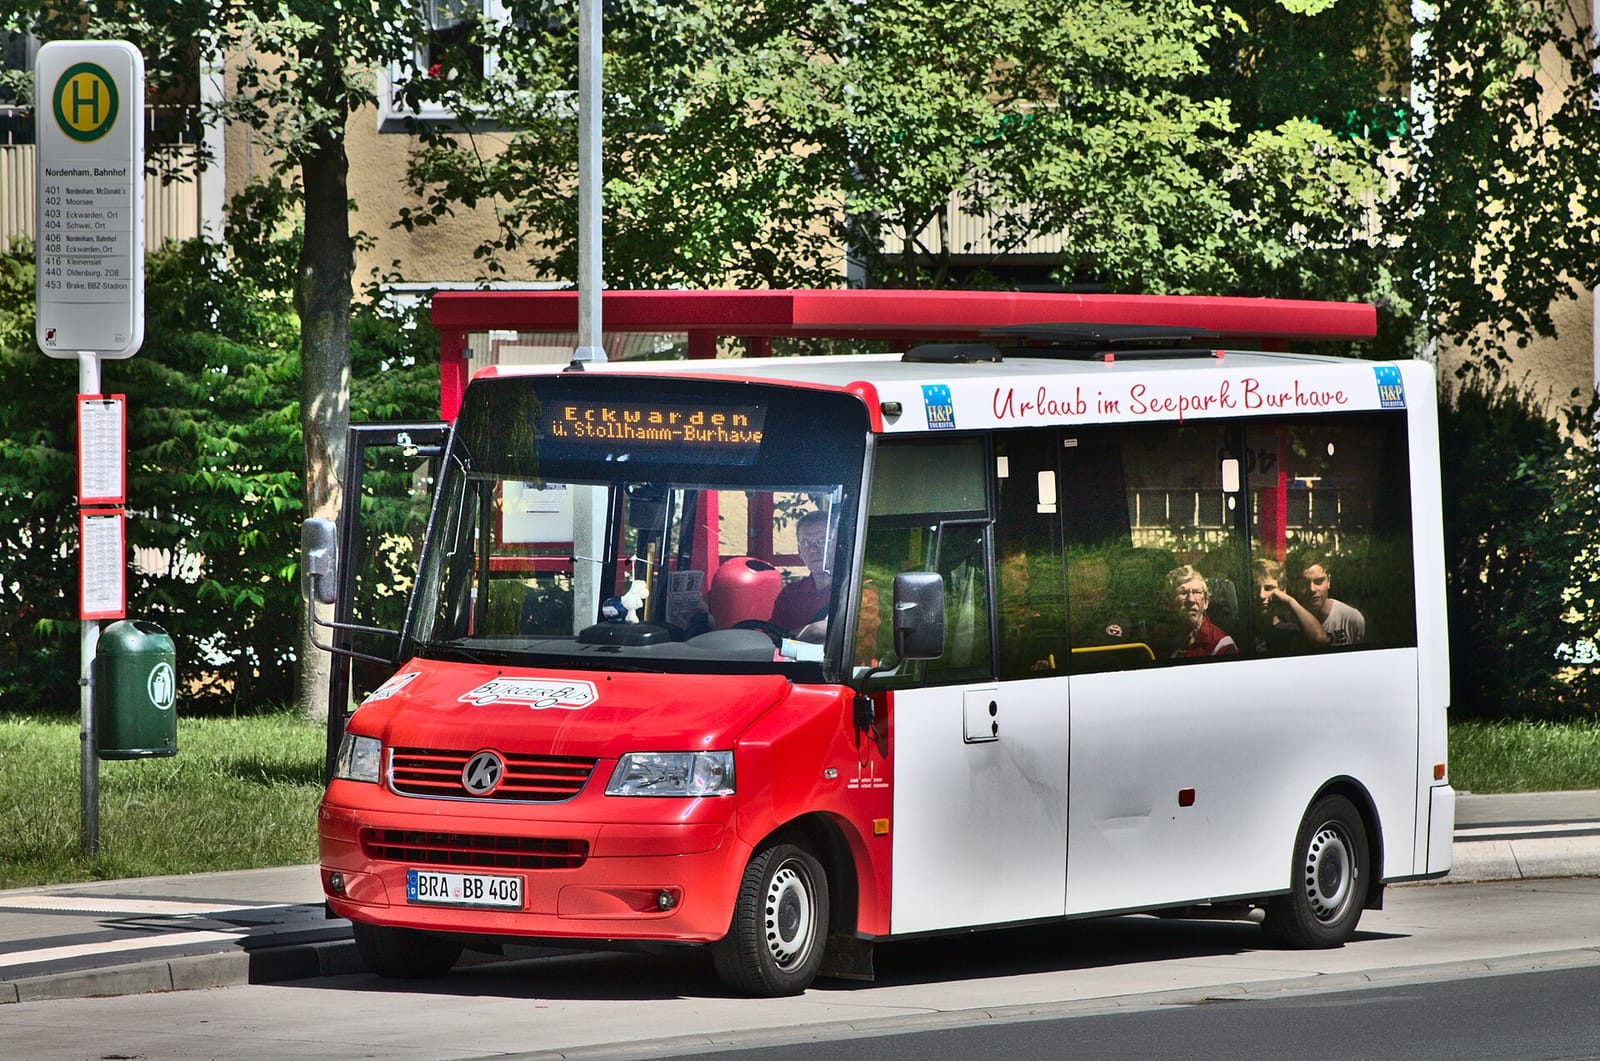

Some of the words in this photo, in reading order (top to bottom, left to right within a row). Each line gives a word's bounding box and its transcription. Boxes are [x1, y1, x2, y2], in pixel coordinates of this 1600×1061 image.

[72, 80, 99, 124] H
[45, 167, 93, 177] Nordenham,
[93, 167, 126, 177] Bahnhof
[45, 186, 60, 195] 401
[45, 197, 61, 206] 402
[66, 198, 93, 206] Moorsee
[45, 209, 61, 218] 403
[66, 211, 105, 219] Eckwarden,
[107, 211, 118, 219] Ort
[45, 220, 61, 229] 404
[66, 221, 92, 230] Schwei,
[45, 234, 61, 242] 406
[96, 234, 117, 242] Bahnhof
[45, 244, 61, 253] 408
[66, 245, 101, 253] Eckwarden,
[102, 245, 113, 253] Ort
[45, 257, 61, 265] 416
[45, 268, 61, 276] 440
[66, 268, 103, 278] Oldenburg,
[104, 269, 120, 277] ZOB
[45, 280, 61, 289] 453
[66, 281, 87, 290] Brake,
[87, 281, 127, 290] BBZ-Stadion
[1380, 385, 1402, 401] H&P
[993, 386, 1087, 419] Urlaub
[1097, 391, 1121, 414] im
[1129, 379, 1237, 424] Seepark
[1240, 378, 1349, 409] Burhave
[564, 406, 748, 426] Eckwarden
[928, 405, 953, 422] H&P
[552, 420, 568, 437] ü.
[574, 421, 764, 443] Stollhamm-Burhave
[419, 876, 449, 897] BRA
[463, 878, 484, 899] BB
[489, 879, 518, 901] 408
